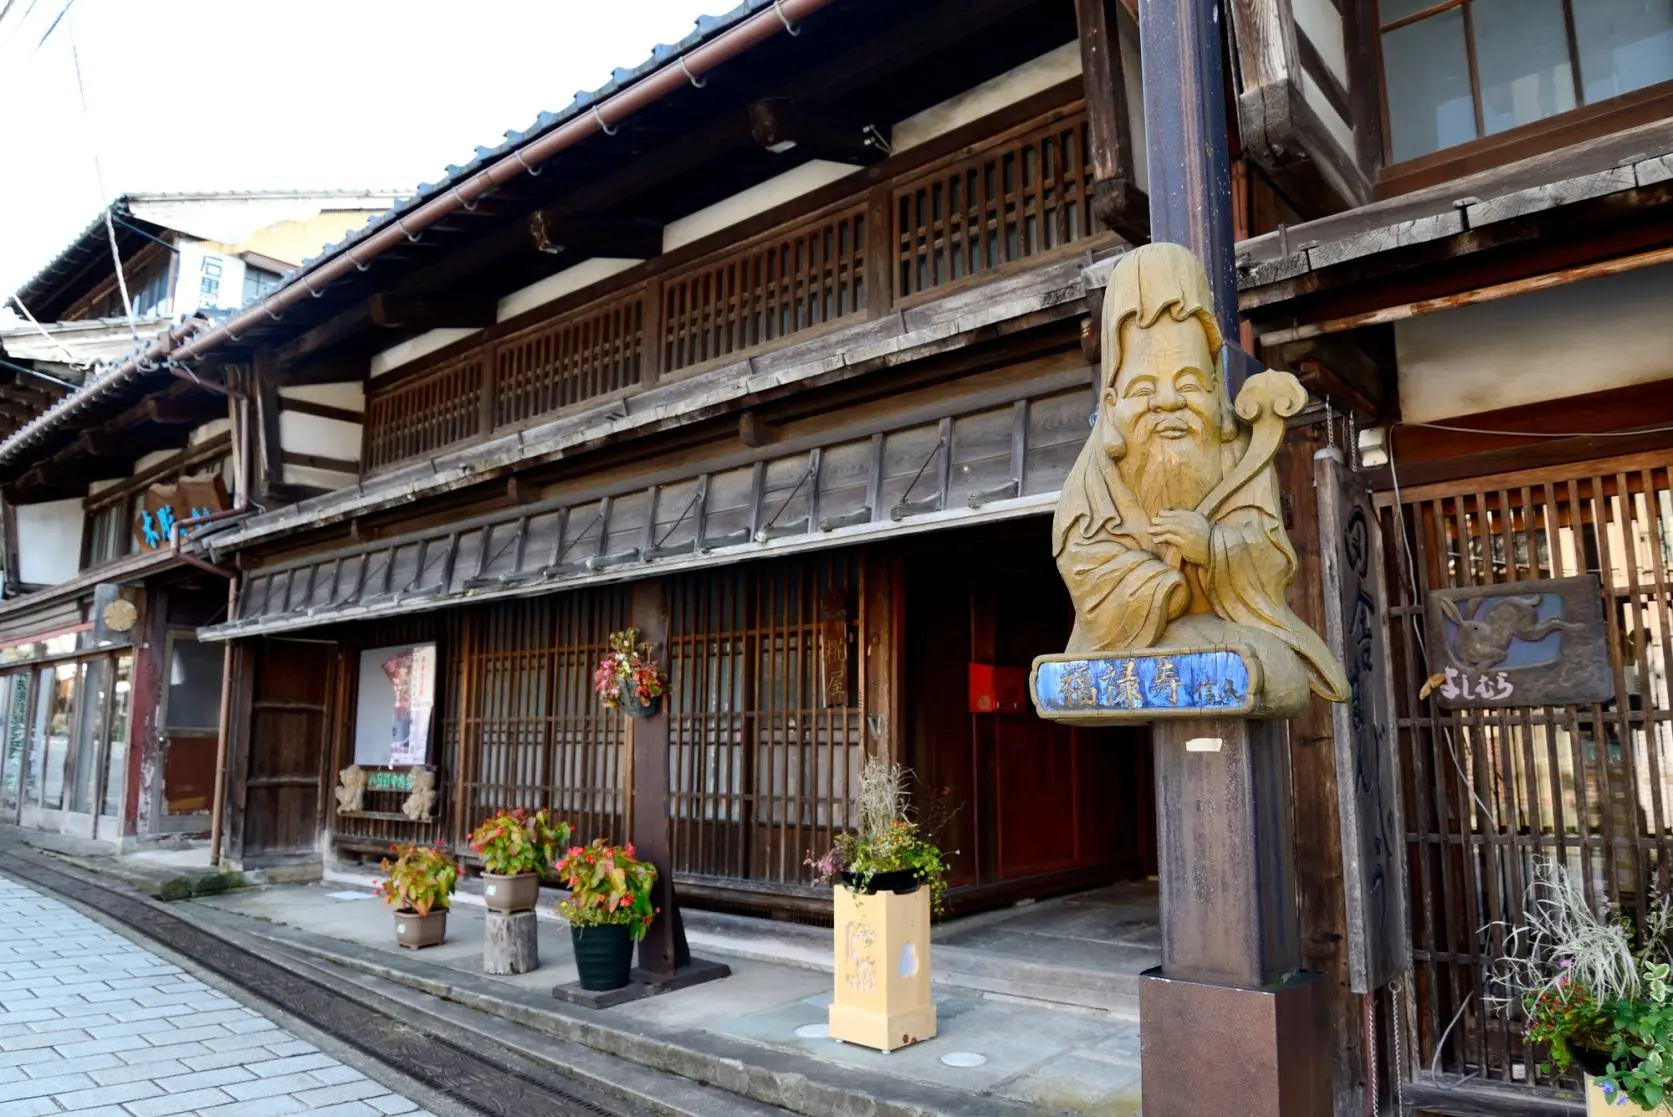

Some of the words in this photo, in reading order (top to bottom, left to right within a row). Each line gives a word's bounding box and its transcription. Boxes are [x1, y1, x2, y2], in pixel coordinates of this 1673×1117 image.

[200, 255, 224, 306] 石黒
[1440, 665, 1515, 700] よしむら
